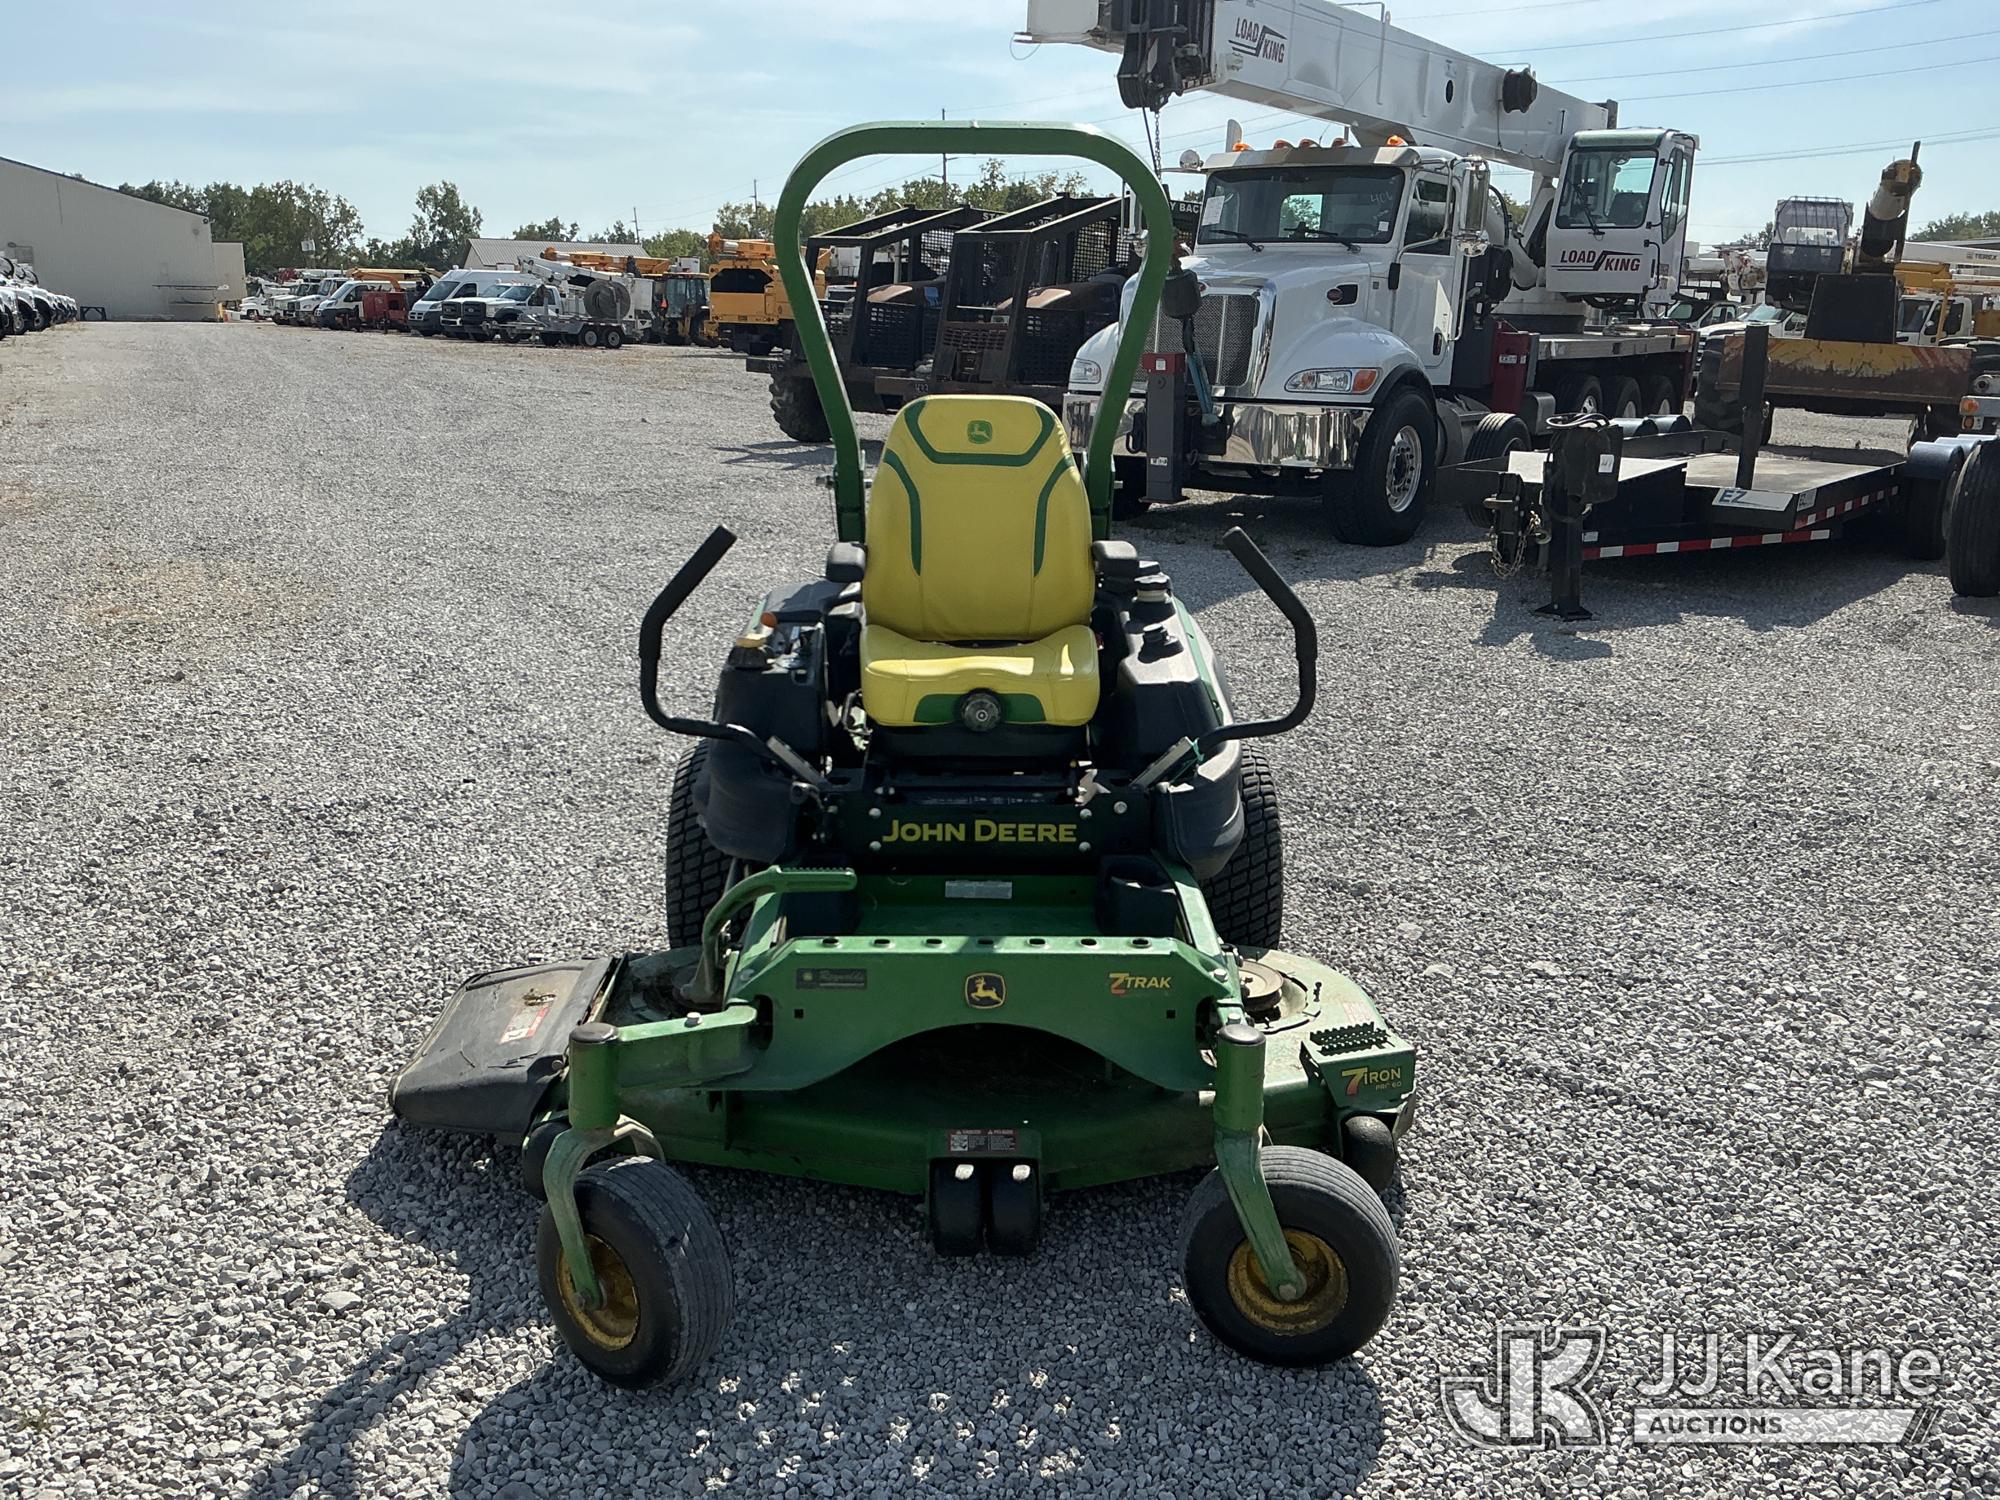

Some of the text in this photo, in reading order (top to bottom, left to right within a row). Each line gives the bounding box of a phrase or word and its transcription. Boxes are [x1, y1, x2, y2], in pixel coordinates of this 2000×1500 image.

[1235, 17, 1260, 43] LOAD
[1262, 38, 1285, 63] KING
[1560, 250, 1596, 263] LOAD
[1604, 258, 1641, 271] KING
[882, 819, 1077, 842] JOHN DEERE
